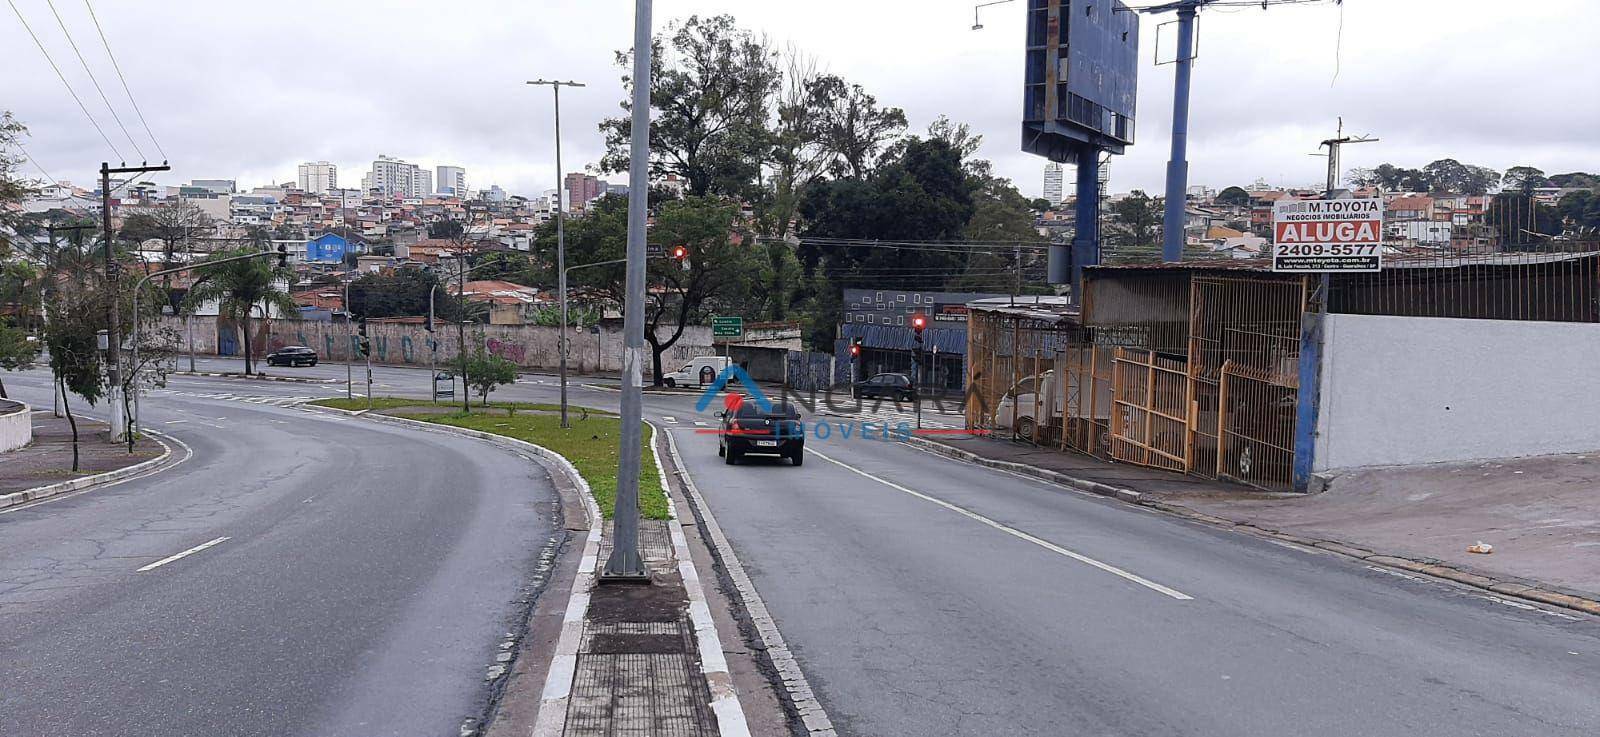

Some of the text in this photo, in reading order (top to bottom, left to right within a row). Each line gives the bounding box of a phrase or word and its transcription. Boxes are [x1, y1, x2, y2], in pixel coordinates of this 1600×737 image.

[1308, 201, 1378, 212] M.TOYOTA
[1281, 223, 1375, 242] ALUGA
[1278, 244, 1378, 256] 2409-5577
[1283, 257, 1371, 265] www.mtoyota.com.br
